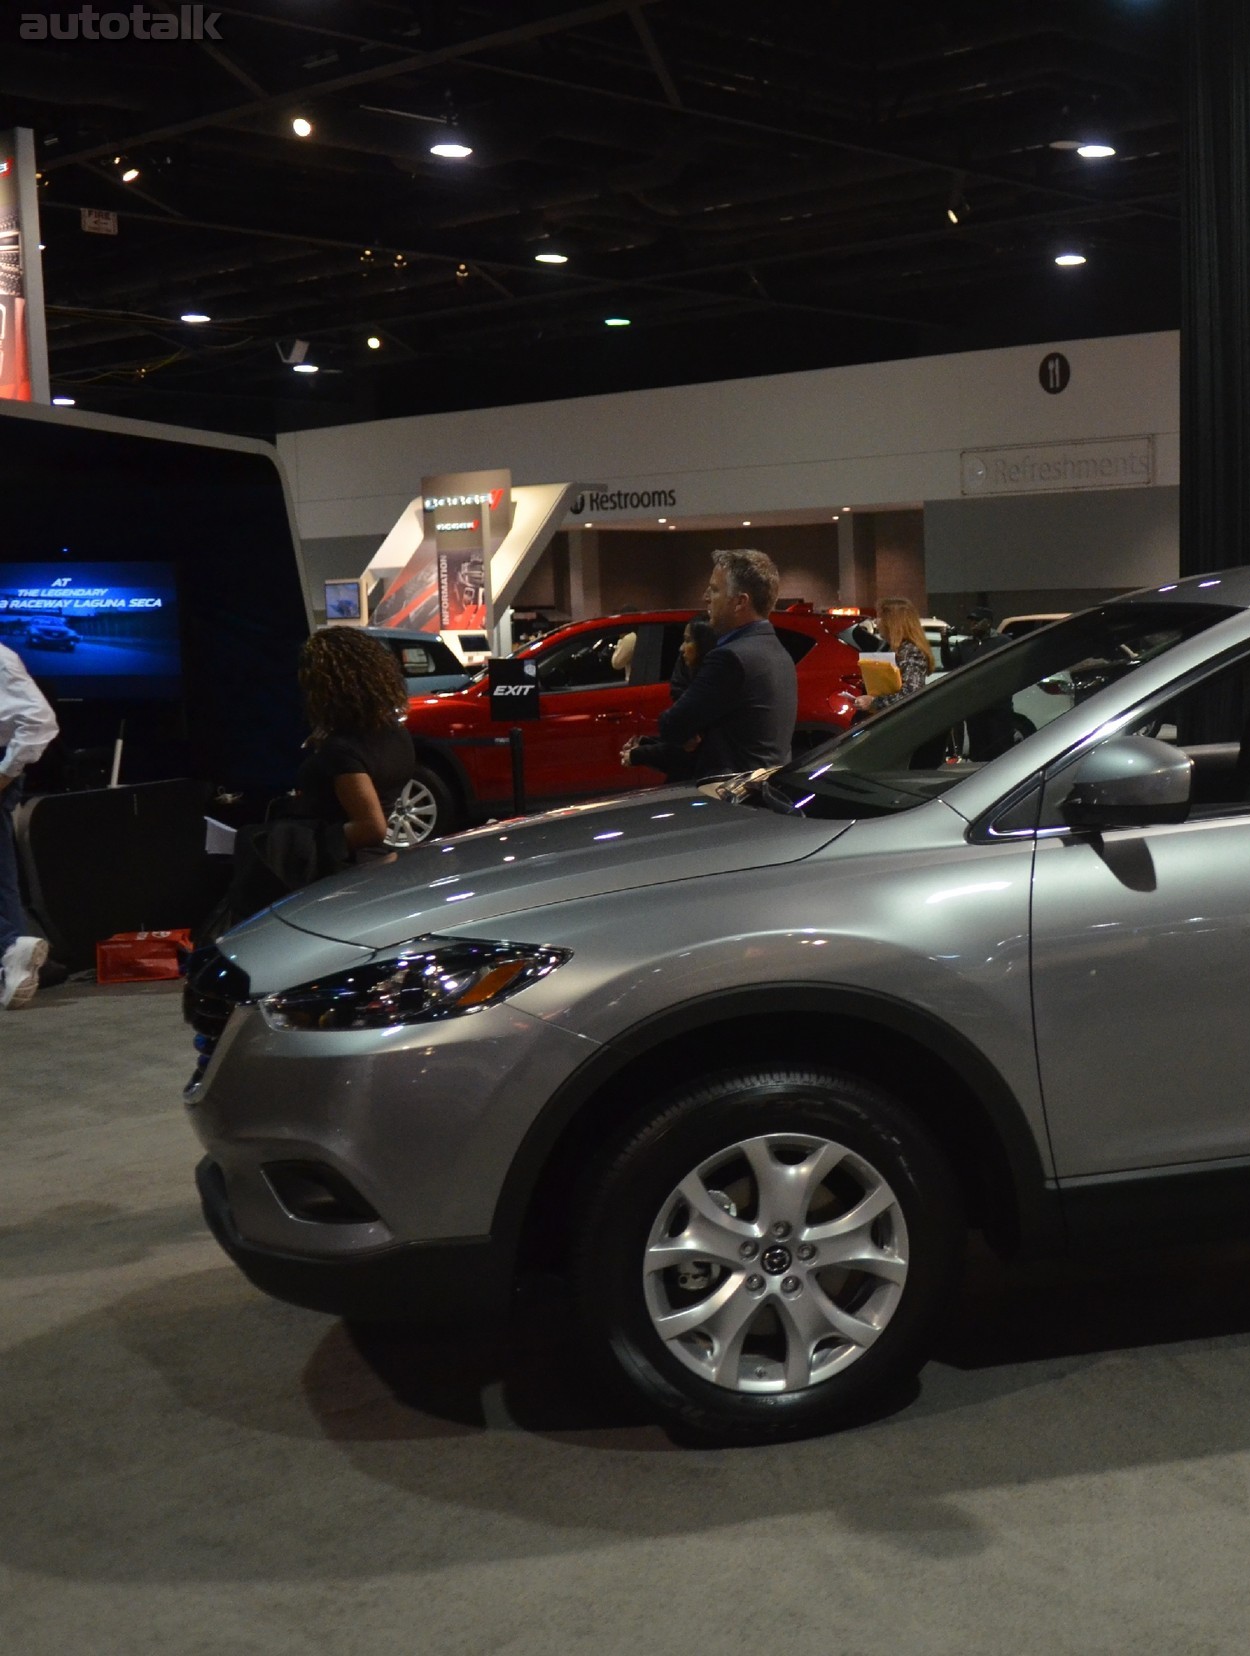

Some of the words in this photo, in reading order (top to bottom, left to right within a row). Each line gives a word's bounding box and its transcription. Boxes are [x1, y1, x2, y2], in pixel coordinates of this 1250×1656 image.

[995, 454, 1148, 483] Refreshments
[590, 489, 676, 511] Restrooms
[51, 578, 72, 587] AT
[17, 588, 39, 598] THE
[40, 588, 109, 598] LEGENDARY
[440, 555, 449, 625] INFORMATION
[9, 599, 71, 608] RACEWAY
[73, 599, 126, 608] LAGUNA
[128, 598, 163, 608] SECA
[493, 684, 535, 696] EXIT
